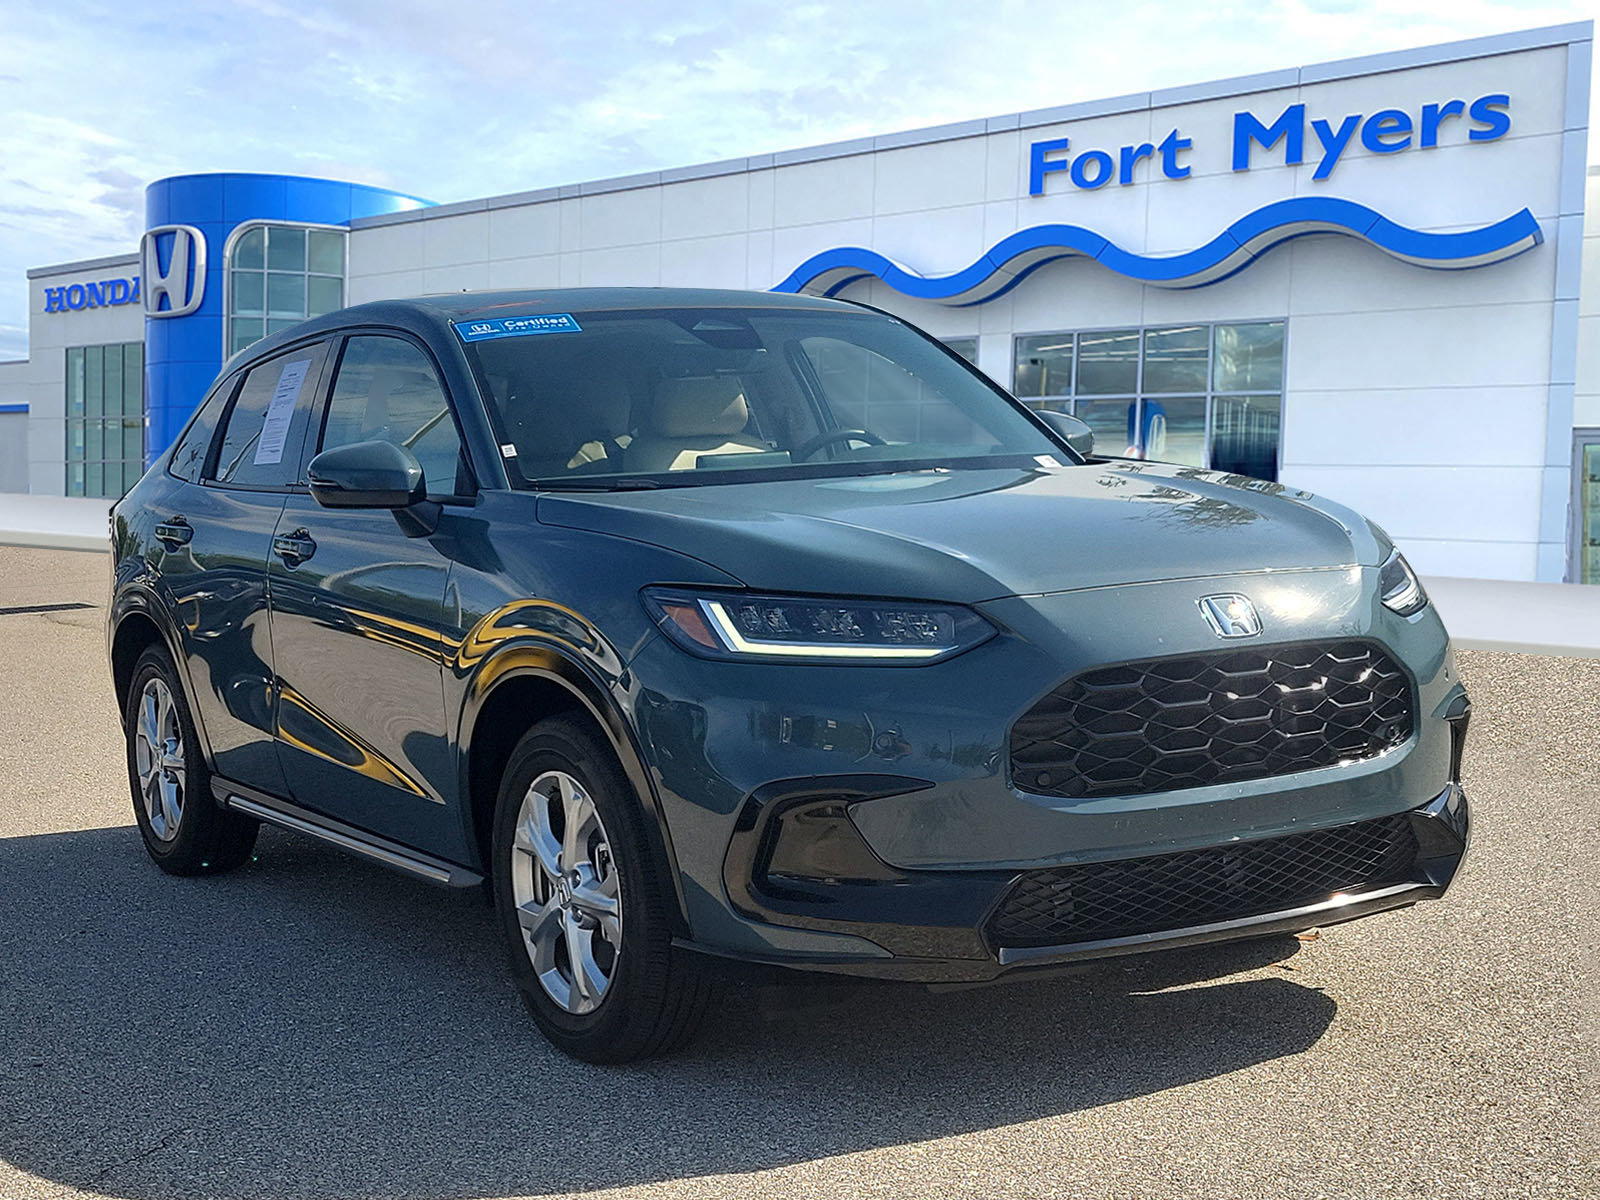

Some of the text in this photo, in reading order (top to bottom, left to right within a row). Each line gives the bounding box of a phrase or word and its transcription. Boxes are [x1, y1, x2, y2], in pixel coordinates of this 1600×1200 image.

[1029, 94, 1511, 196] Fort Myers
[504, 316, 569, 328] Certified
